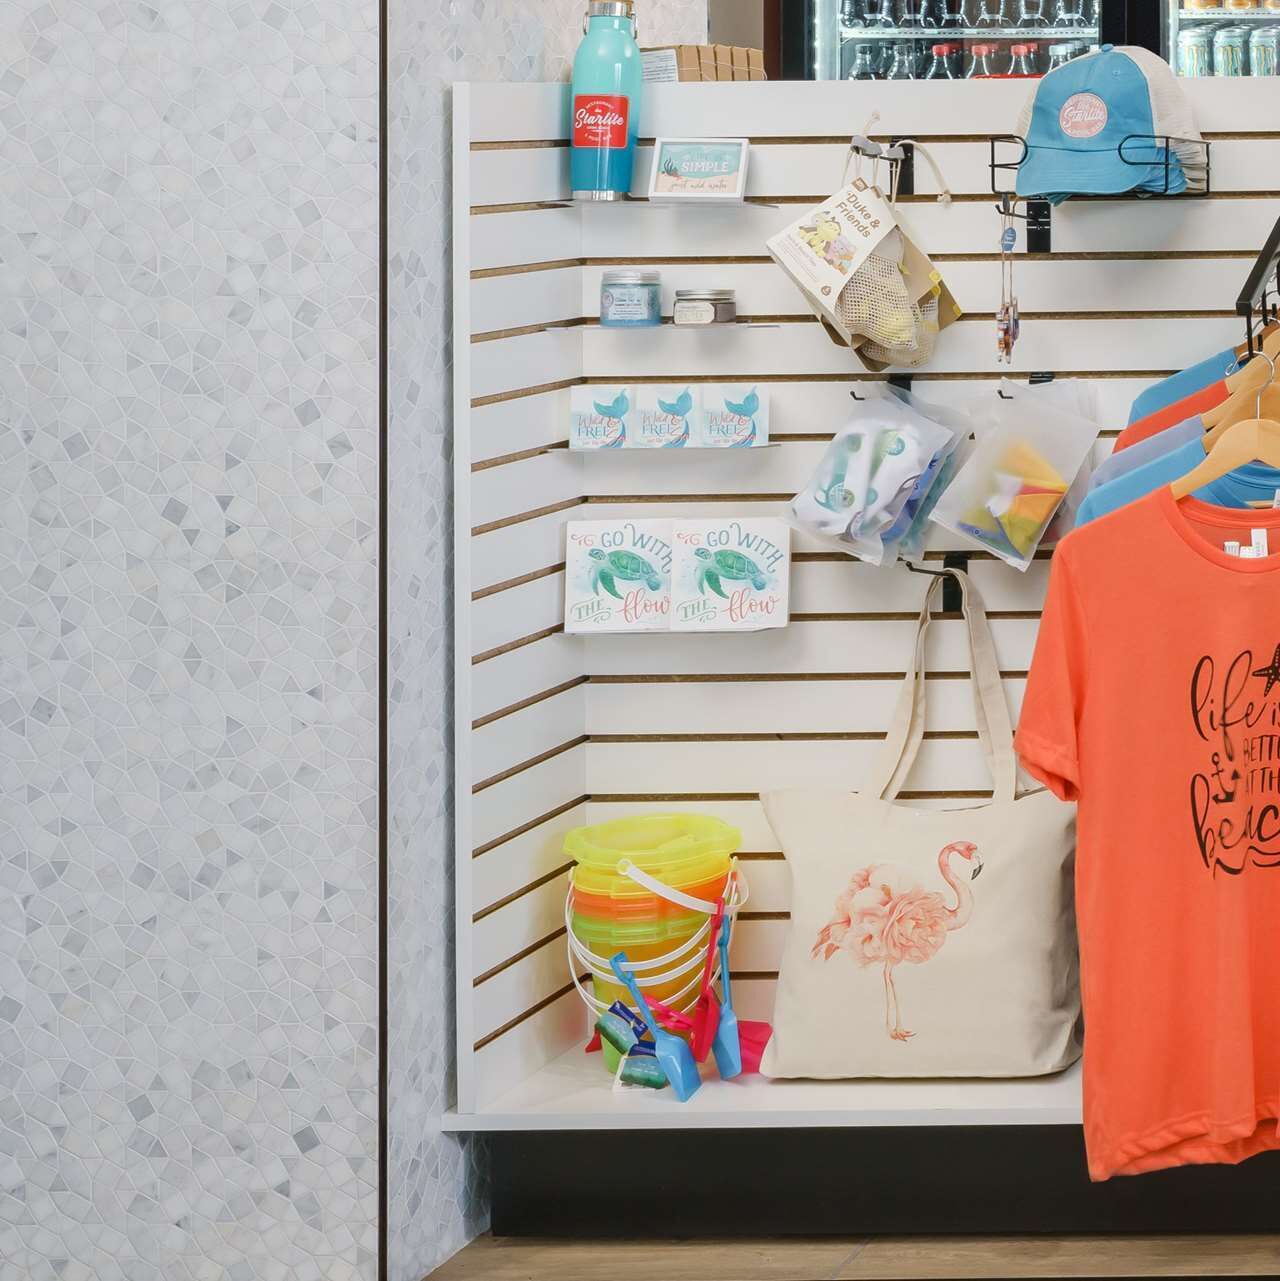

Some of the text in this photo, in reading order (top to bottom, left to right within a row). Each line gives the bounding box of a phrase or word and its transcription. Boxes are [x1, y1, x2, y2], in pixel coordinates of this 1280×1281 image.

[574, 108, 625, 129] Starlite
[682, 160, 729, 173] SIMPLE
[835, 201, 871, 239] Friends
[847, 191, 881, 230] Duke &
[601, 530, 624, 548] GO
[623, 522, 673, 575] WITH
[706, 522, 784, 574] GO WITH
[573, 599, 605, 619] THE
[615, 588, 671, 624] flow
[680, 598, 711, 619] THE
[720, 587, 781, 623] flow
[1190, 650, 1267, 762] life
